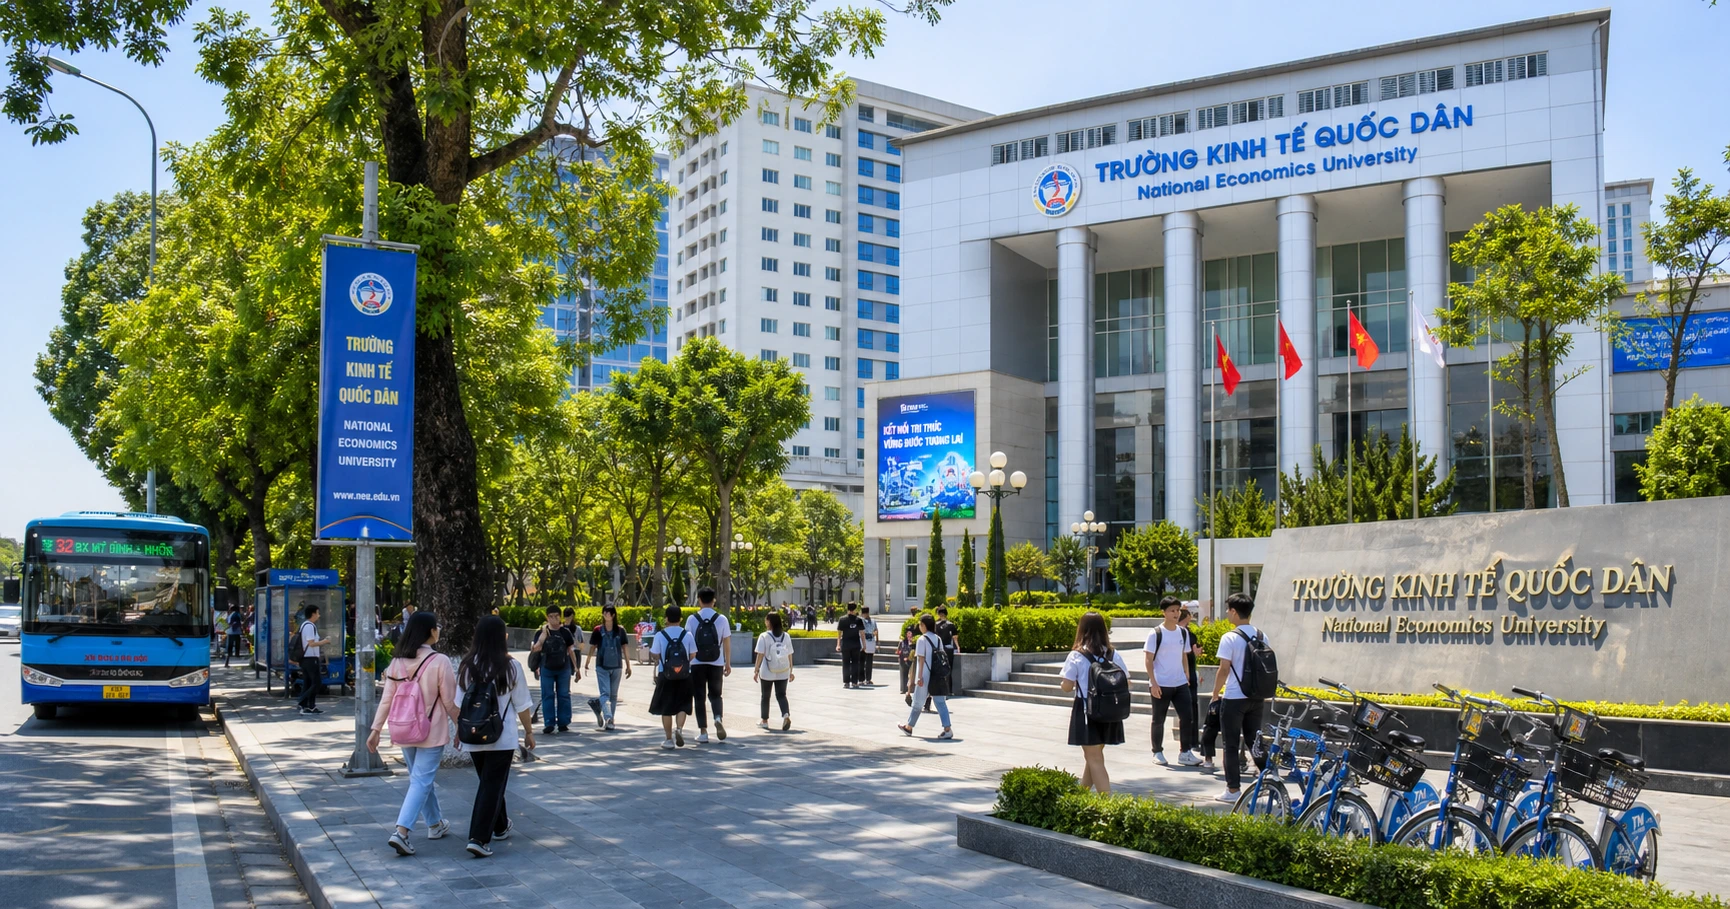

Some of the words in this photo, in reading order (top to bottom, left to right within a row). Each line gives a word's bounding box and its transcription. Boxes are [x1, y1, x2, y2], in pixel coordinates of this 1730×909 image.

[1095, 149, 1199, 183] TRƯỜNG
[1207, 137, 1267, 166] KINH
[1275, 122, 1309, 155] TẾ
[1314, 110, 1400, 148] QUỐC
[1411, 102, 1473, 135] DÂN
[1137, 175, 1210, 200] National
[1216, 162, 1317, 189] Economics
[1323, 146, 1418, 173] University
[346, 334, 394, 355] TRƯỜNG
[346, 361, 375, 379] KINH
[378, 360, 394, 380] TẾ
[339, 384, 372, 405] QUỐC
[374, 387, 399, 406] DÂN
[343, 420, 393, 433] NATIONAL
[338, 437, 398, 451] ECONOMICS
[338, 455, 397, 468] UNIVERSITY
[56, 538, 74, 554] 32
[1291, 569, 1386, 601] TRƯỜNG
[1390, 572, 1459, 600] KINH
[1463, 556, 1503, 598] TẾ
[1504, 555, 1593, 603] QUỐC
[1599, 557, 1673, 595] DÂN
[1321, 614, 1391, 634] National
[1395, 614, 1494, 635] Economics
[1500, 614, 1606, 640] University
